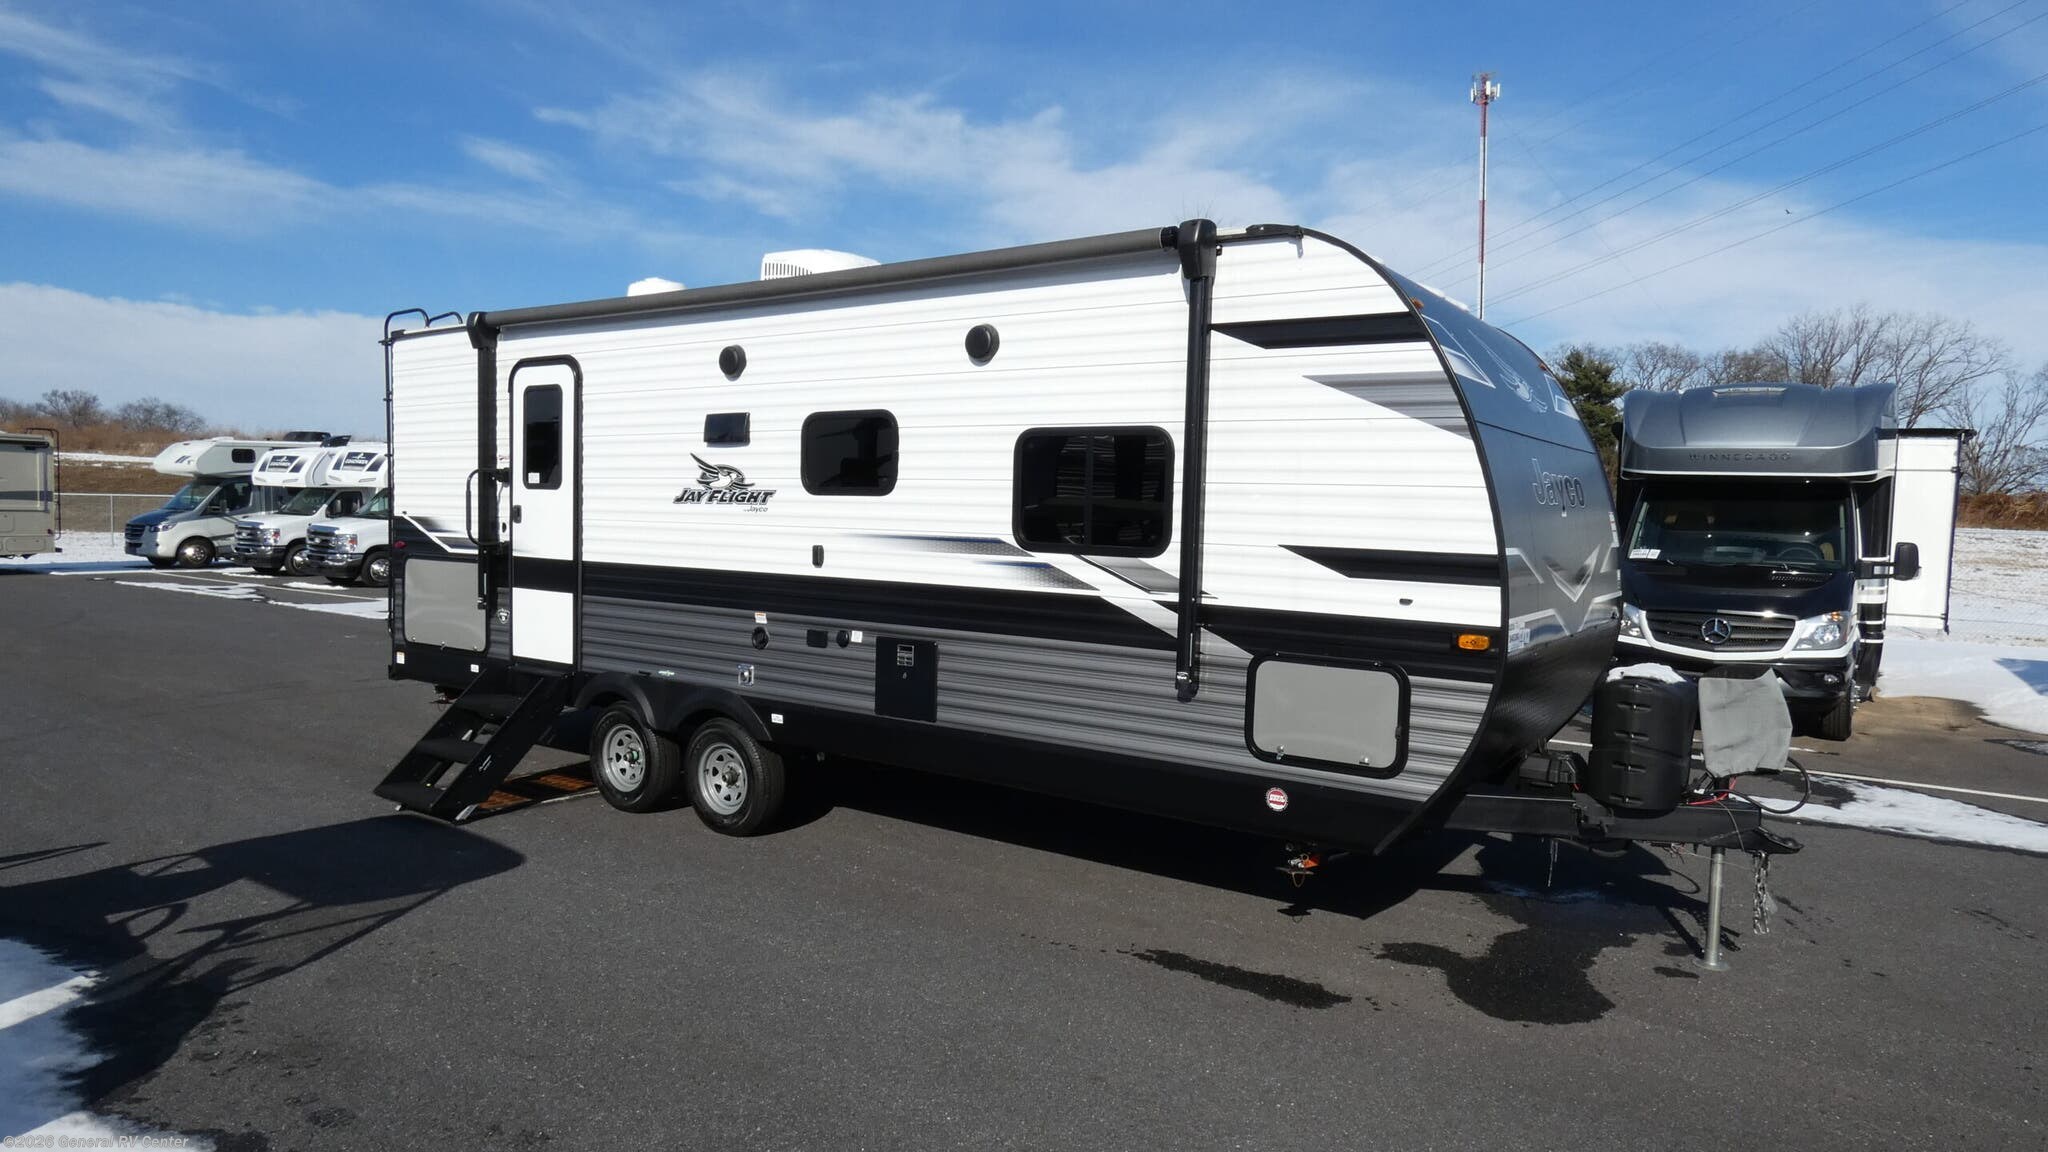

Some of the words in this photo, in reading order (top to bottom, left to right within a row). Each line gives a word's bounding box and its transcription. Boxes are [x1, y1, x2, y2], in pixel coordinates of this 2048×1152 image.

[673, 487, 707, 504] JAY
[705, 488, 776, 505] FLIGHT
[1532, 458, 1585, 517] Jayco
